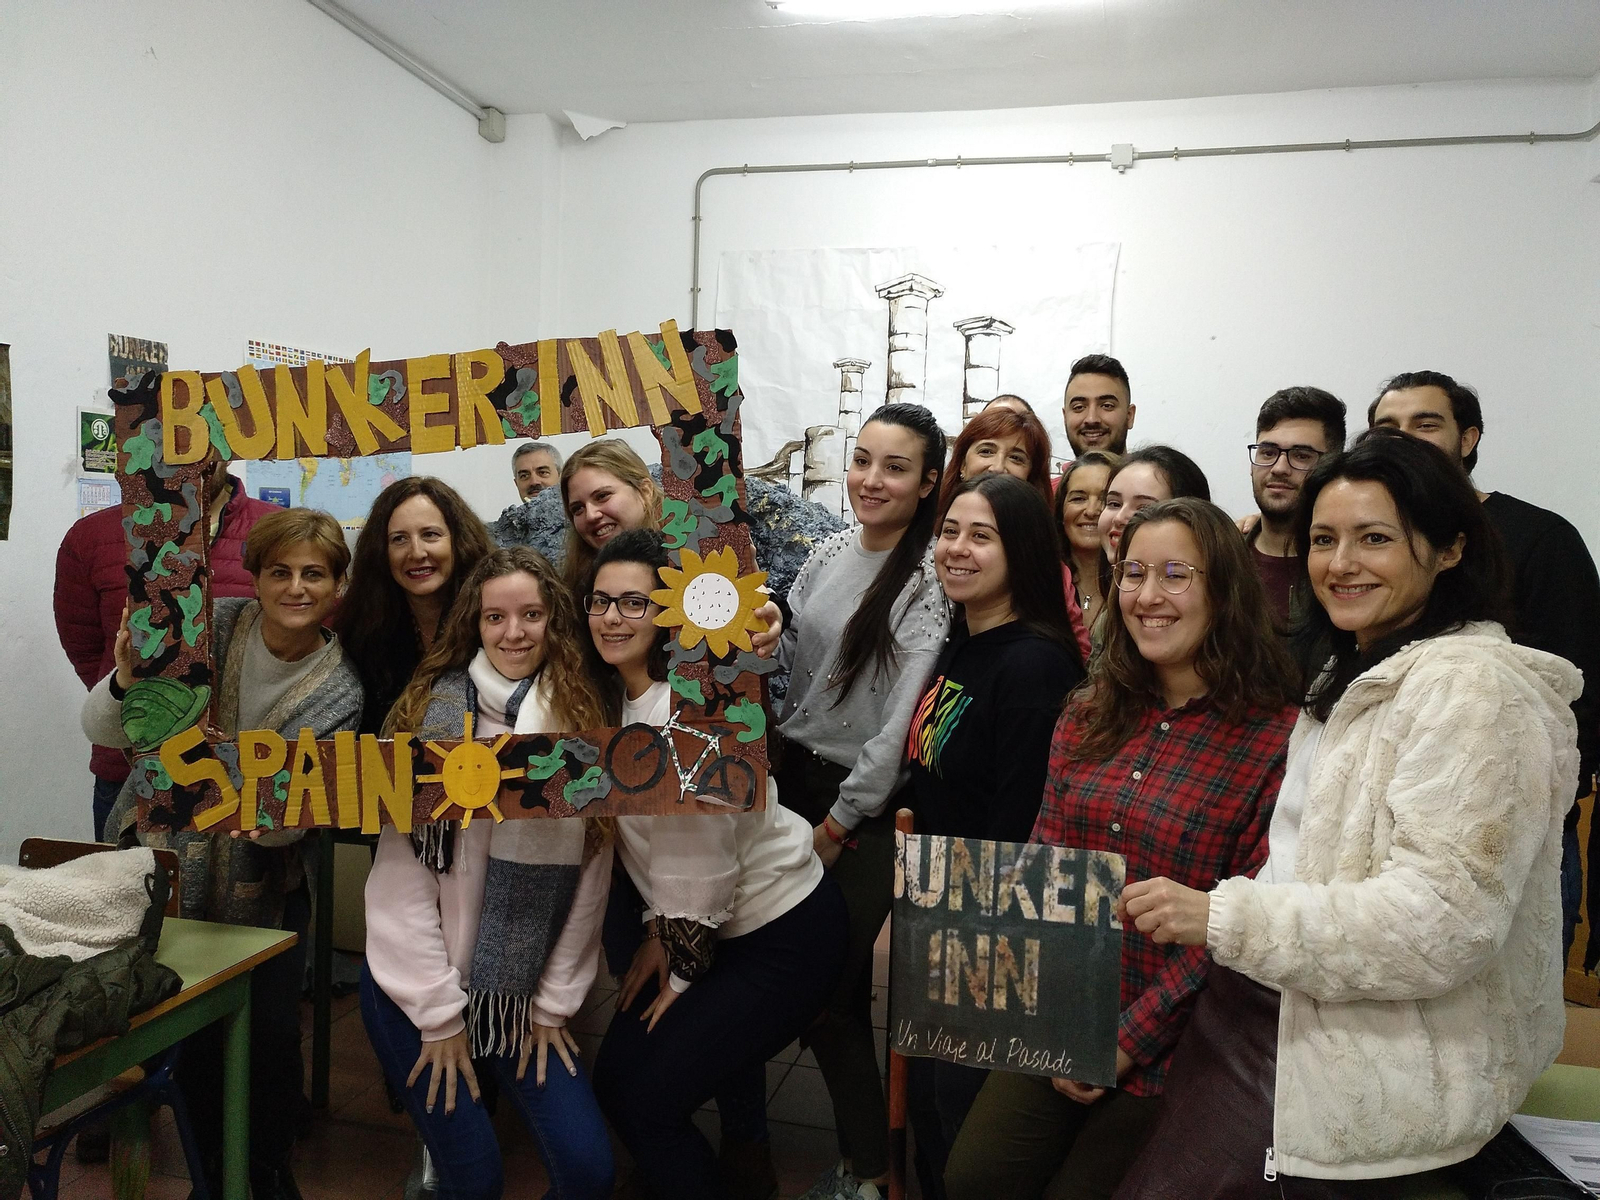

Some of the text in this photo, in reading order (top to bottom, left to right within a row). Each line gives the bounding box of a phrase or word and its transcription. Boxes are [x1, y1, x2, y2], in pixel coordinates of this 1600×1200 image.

[161, 318, 703, 466] BUNKER INN
[159, 724, 413, 835] SPAIN
[928, 928, 1041, 1016] INN
[898, 1018, 1072, 1075] Un Viaje al Pasado
